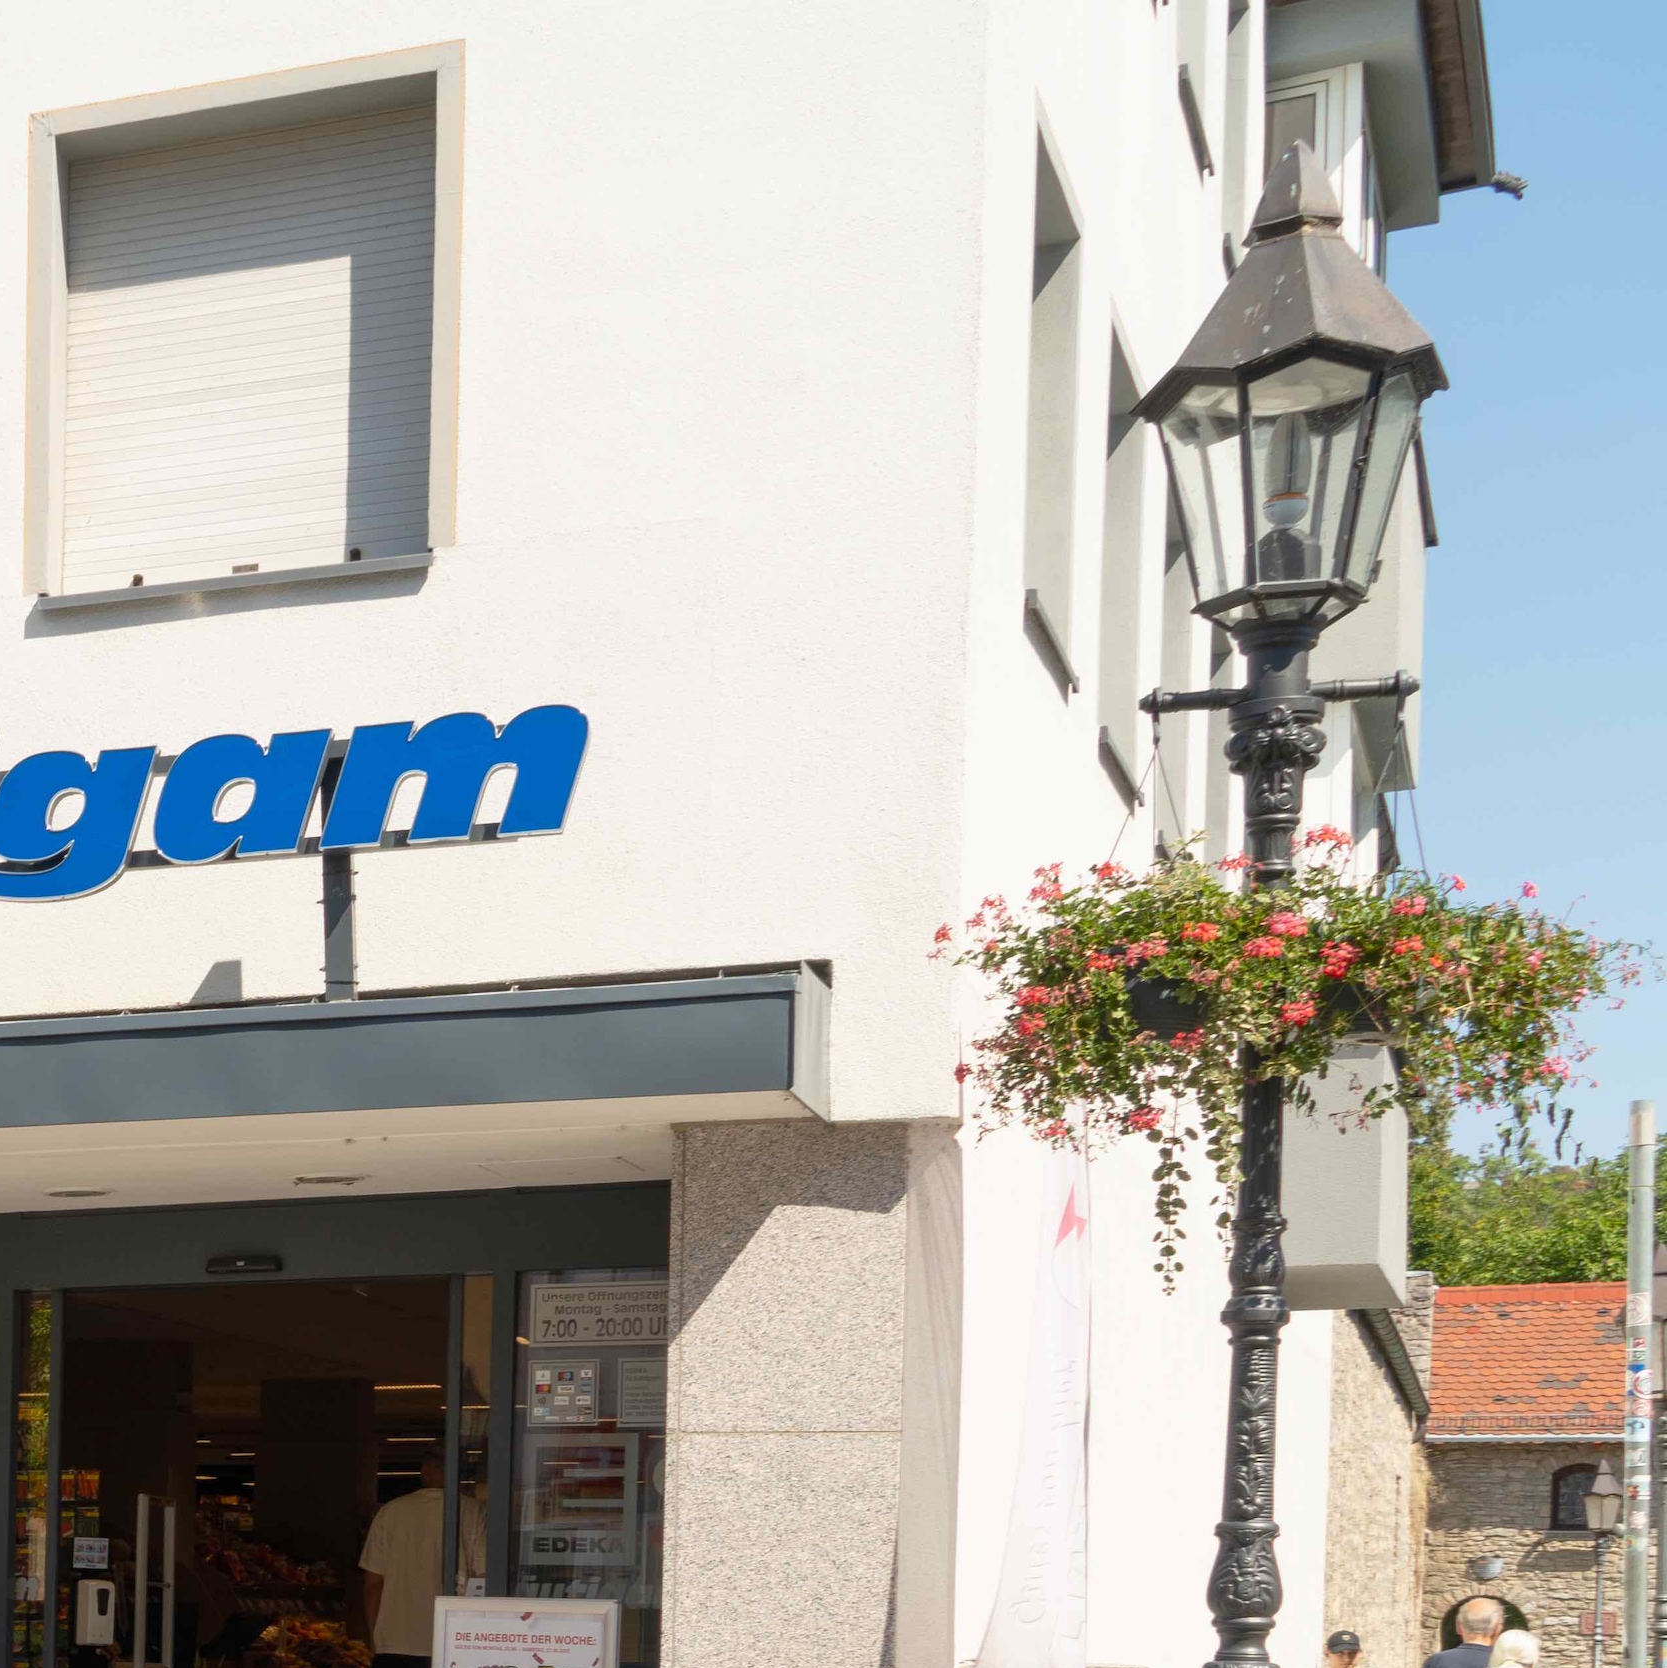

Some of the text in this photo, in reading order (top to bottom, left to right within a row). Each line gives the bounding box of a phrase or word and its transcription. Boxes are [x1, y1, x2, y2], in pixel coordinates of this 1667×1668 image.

[542, 1292, 584, 1303] Unsere
[554, 1304, 602, 1316] Montag
[614, 1303, 667, 1314] Samstag
[541, 1319, 578, 1338] 7:00
[595, 1317, 643, 1337] 20:00
[533, 1537, 624, 1553] EDEKA
[455, 1632, 597, 1646] DIE ANGEBOTE DER WOCHE:
